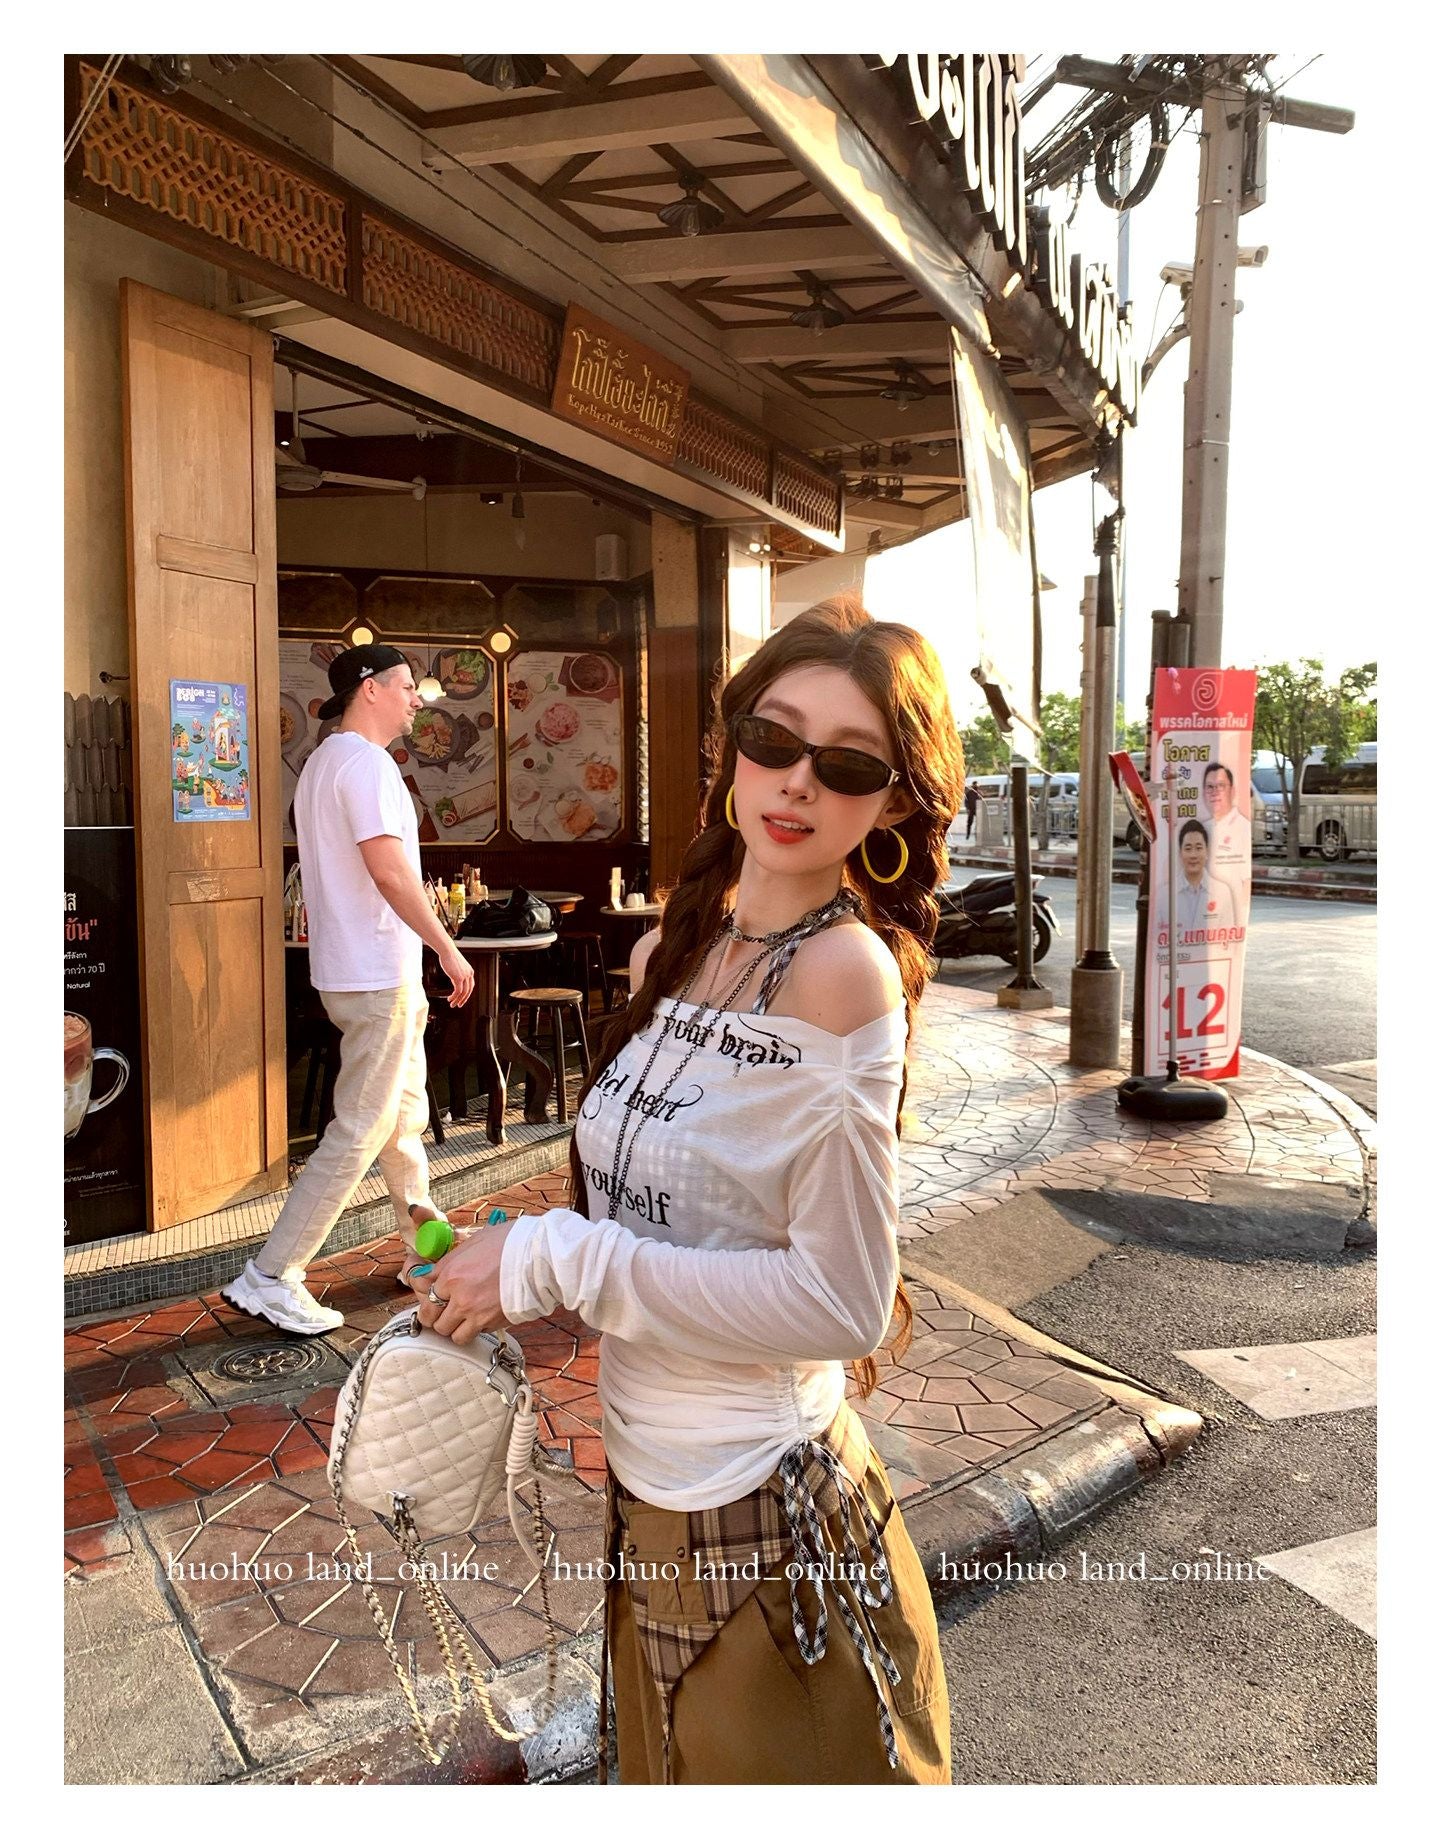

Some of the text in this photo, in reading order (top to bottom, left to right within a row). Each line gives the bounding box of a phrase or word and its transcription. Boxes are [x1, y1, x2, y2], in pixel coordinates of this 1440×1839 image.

[1159, 712, 1249, 729] พรรคโอกาสใหม่
[1162, 738, 1210, 763] โอกาส
[87, 965, 98, 974] 70
[66, 981, 91, 990] Natural
[1162, 983, 1226, 1041] 12
